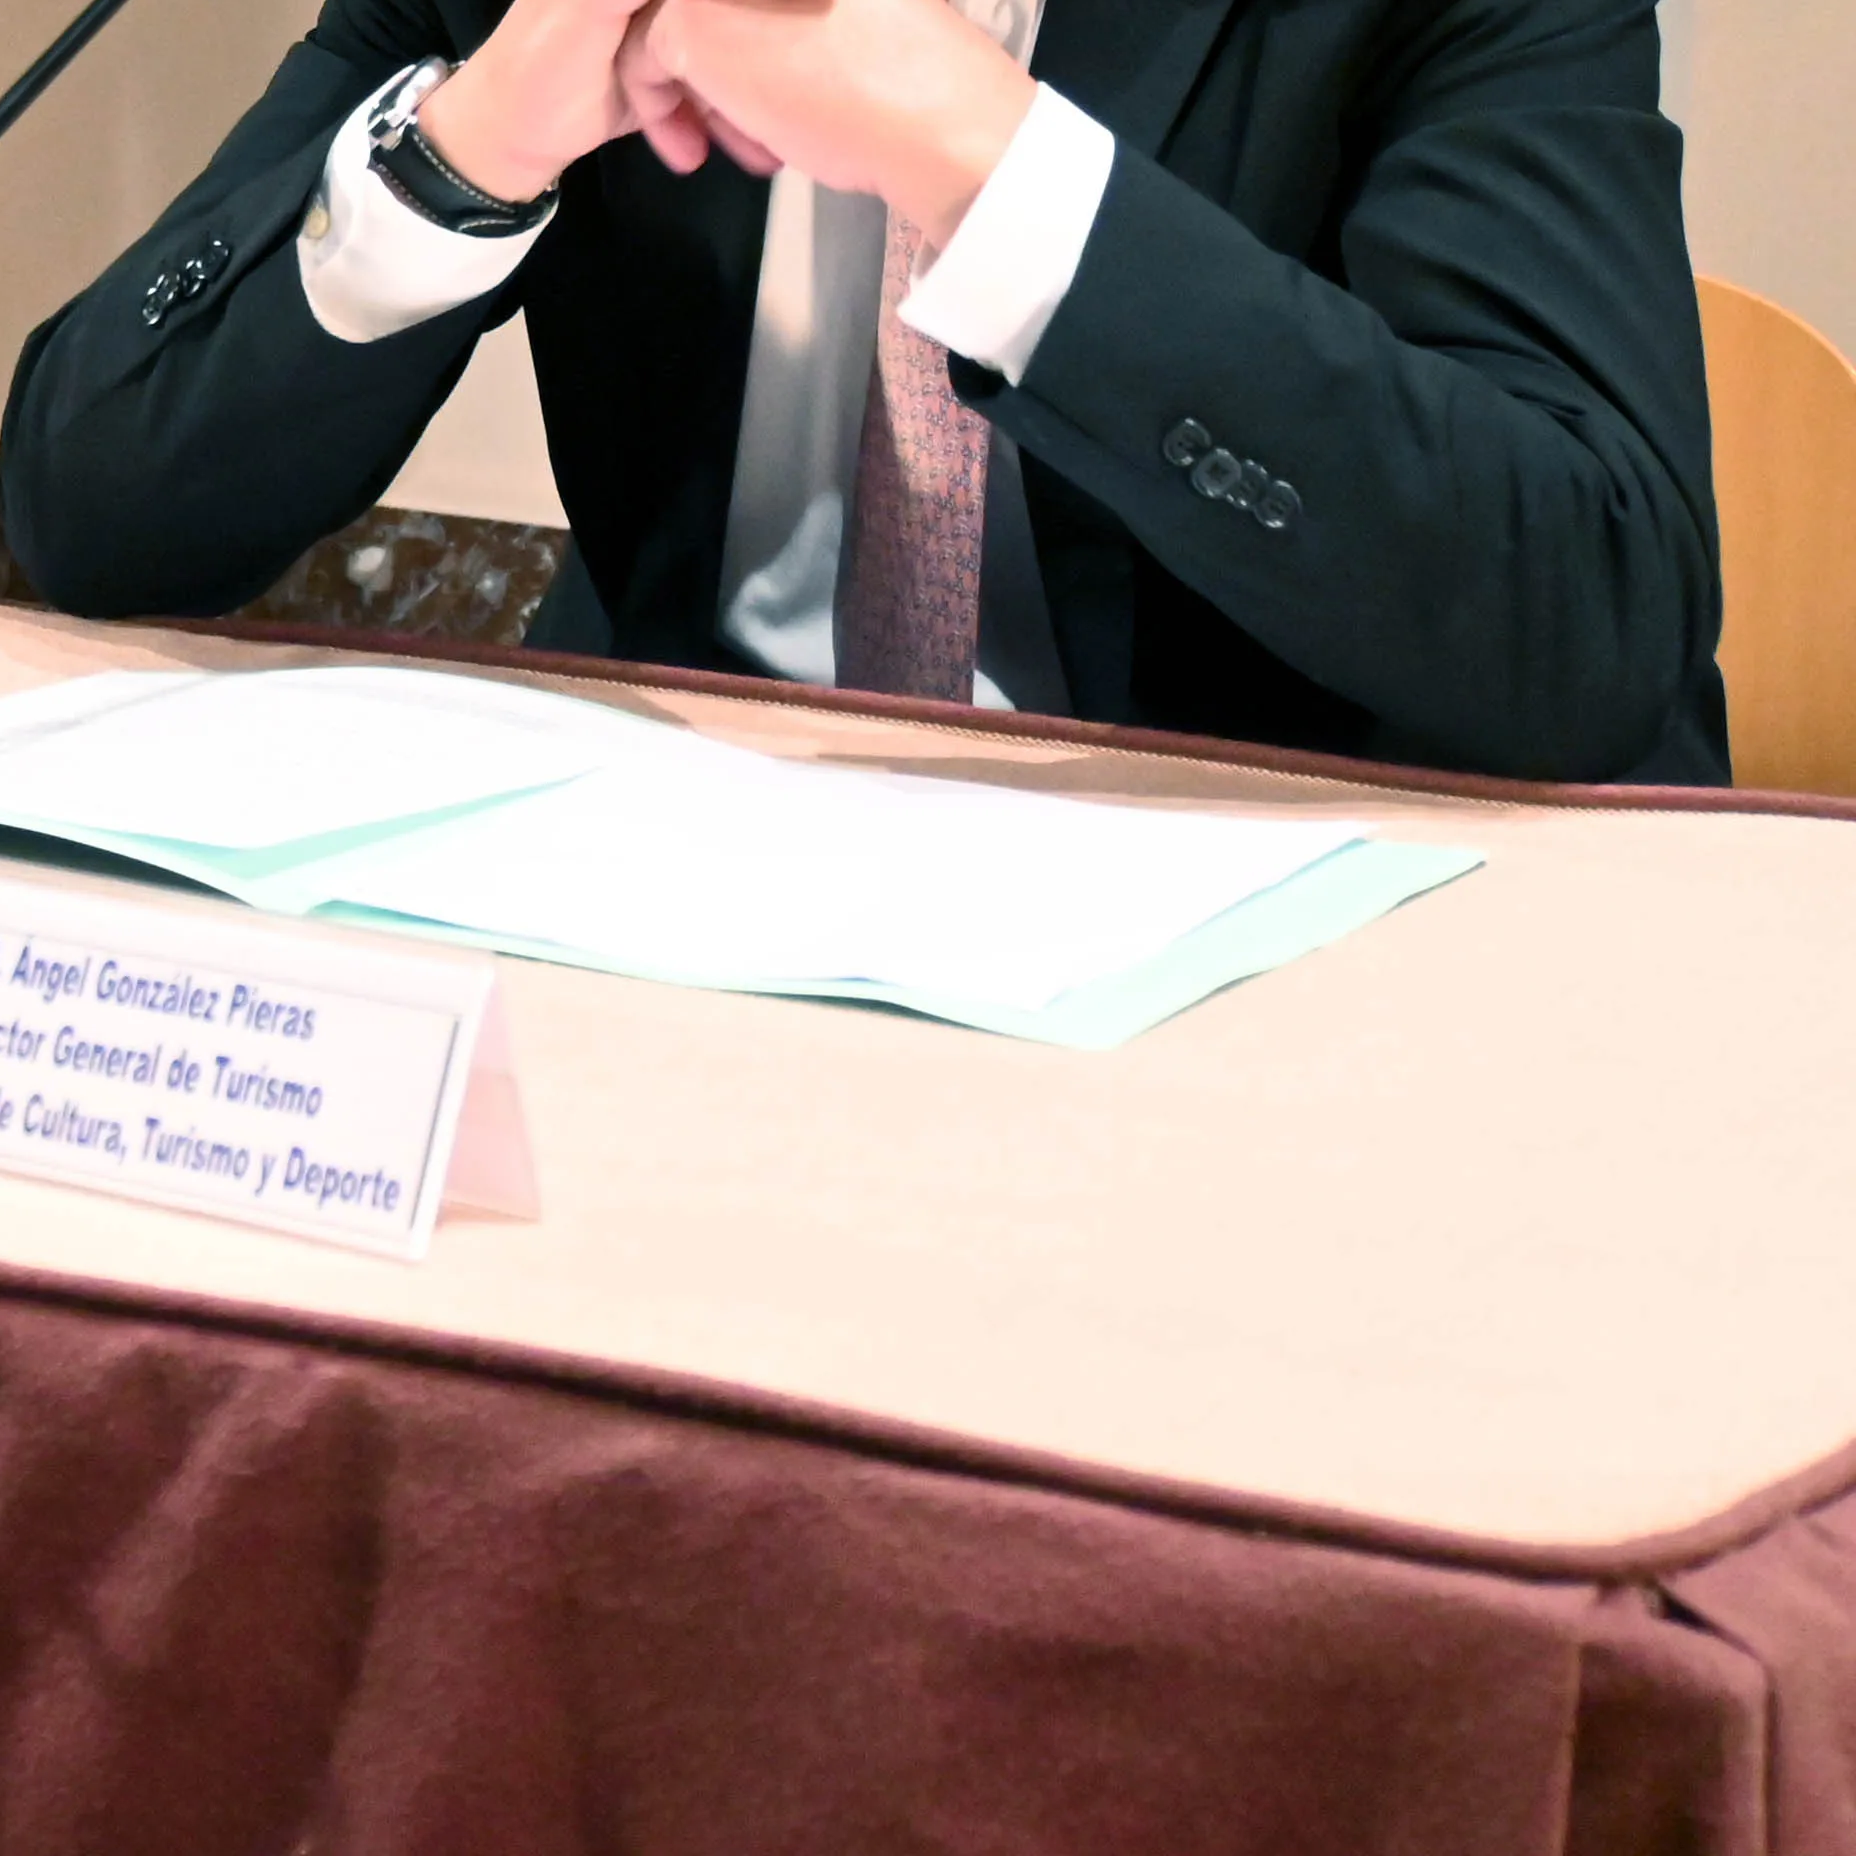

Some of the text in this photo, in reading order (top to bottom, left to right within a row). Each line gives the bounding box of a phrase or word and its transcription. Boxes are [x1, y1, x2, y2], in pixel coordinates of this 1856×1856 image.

[11, 934, 91, 1003] Ángel
[97, 959, 220, 1022] González
[226, 984, 316, 1041] Pieras
[53, 1026, 162, 1086] General
[167, 1048, 200, 1093] de
[213, 1055, 323, 1118] Turismo
[23, 1094, 127, 1165] Cultura,
[143, 1116, 250, 1180] Turismo
[255, 1154, 278, 1197] y
[283, 1147, 400, 1211] Deporte
